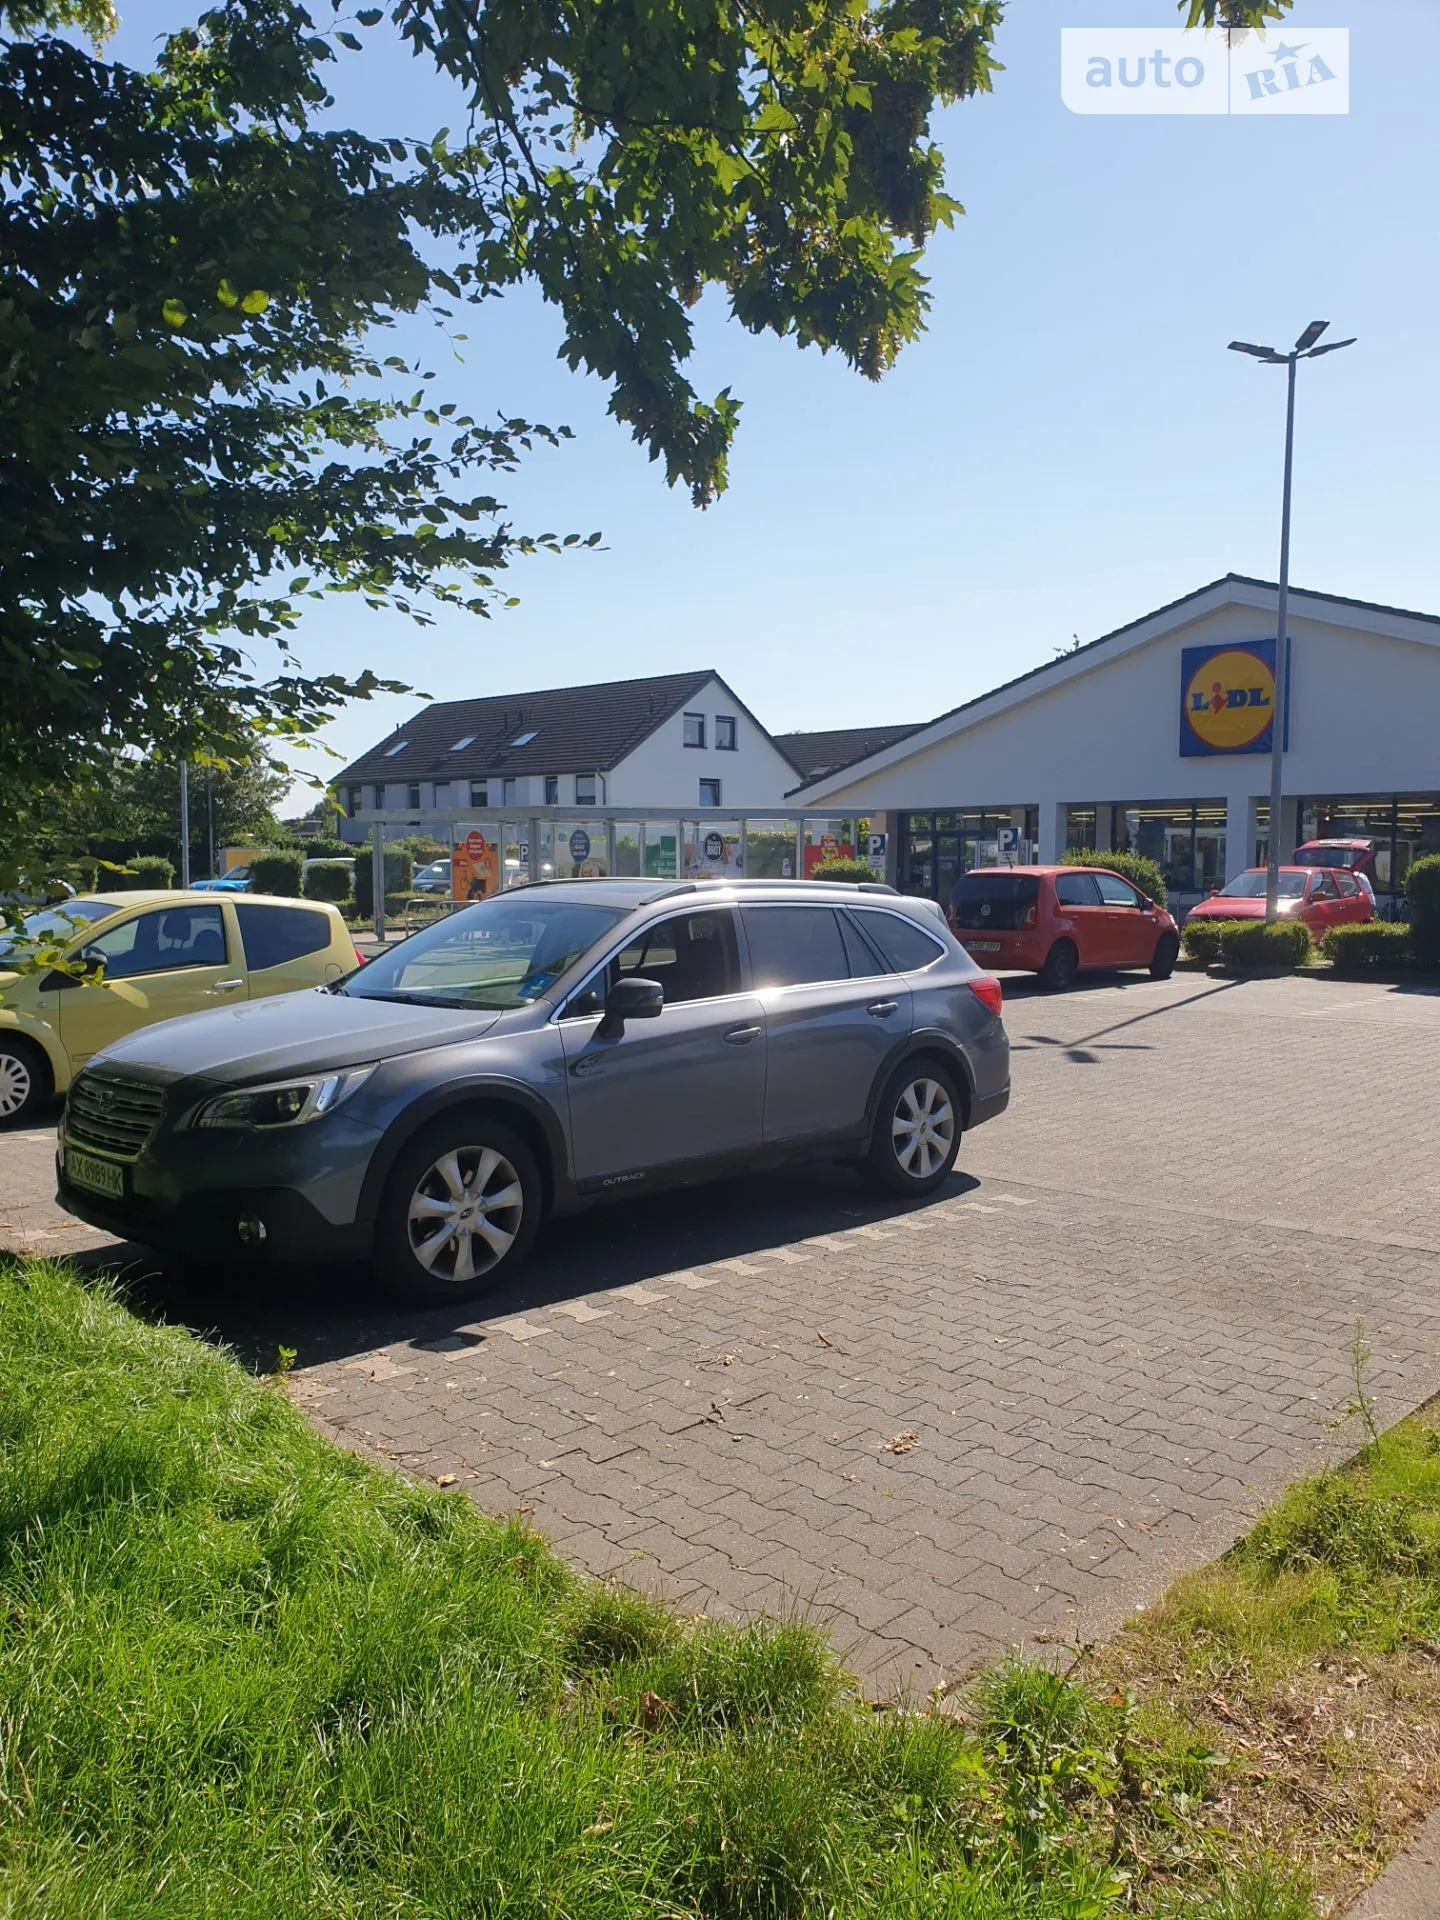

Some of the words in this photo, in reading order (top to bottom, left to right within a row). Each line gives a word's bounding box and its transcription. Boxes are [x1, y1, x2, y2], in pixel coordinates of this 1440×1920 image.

[869, 835, 882, 855] P
[1000, 829, 1014, 851] P
[71, 1154, 83, 1178] AX
[107, 1167, 122, 1193] HK
[603, 1171, 646, 1186] OUTBACK
